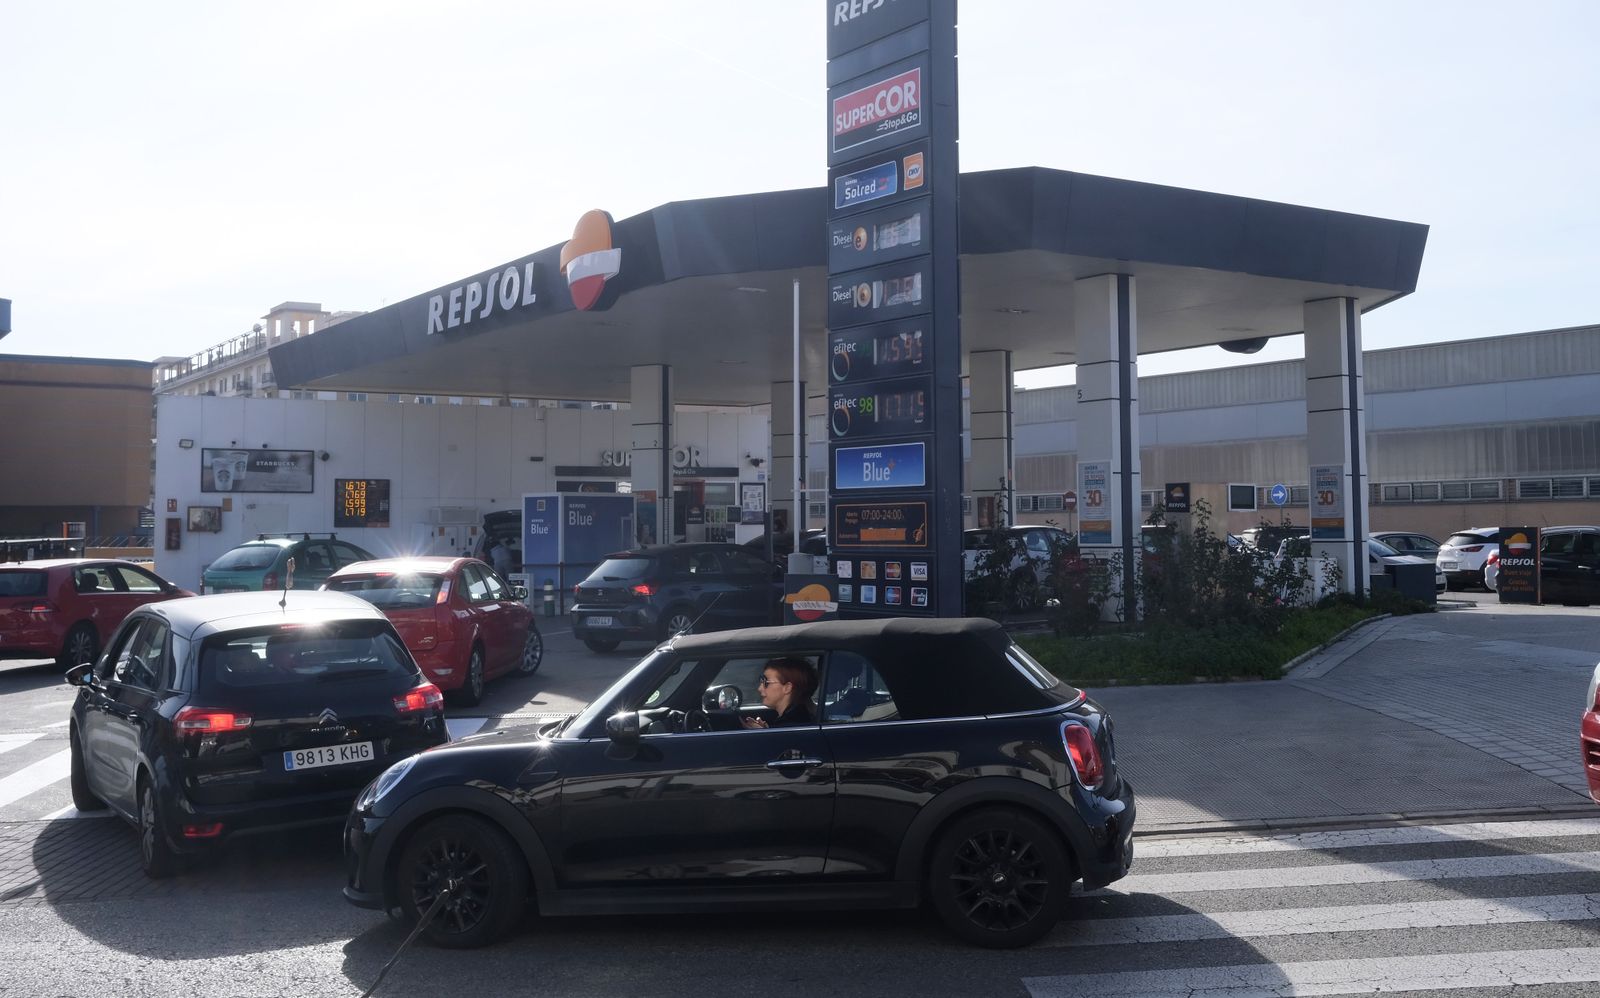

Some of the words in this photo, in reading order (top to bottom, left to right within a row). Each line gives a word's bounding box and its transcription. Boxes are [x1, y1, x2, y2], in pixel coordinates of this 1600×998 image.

[835, 80, 918, 133] SUPERCOR
[884, 111, 918, 131] Stop&Go
[845, 179, 876, 200] Solred
[833, 231, 853, 246] Diesel
[427, 261, 536, 335] REPSOL
[832, 287, 852, 302] Diesel
[833, 342, 857, 354] efitec
[1077, 388, 1083, 399] 5
[833, 397, 857, 409] efitec
[859, 396, 873, 414] 98
[863, 462, 891, 482] Blue
[568, 510, 593, 526] Blue
[530, 523, 549, 535] Blue
[1500, 558, 1535, 566] REPSOL
[913, 567, 926, 576] VISA
[295, 748, 335, 766] 9813
[340, 744, 369, 761] KHG
